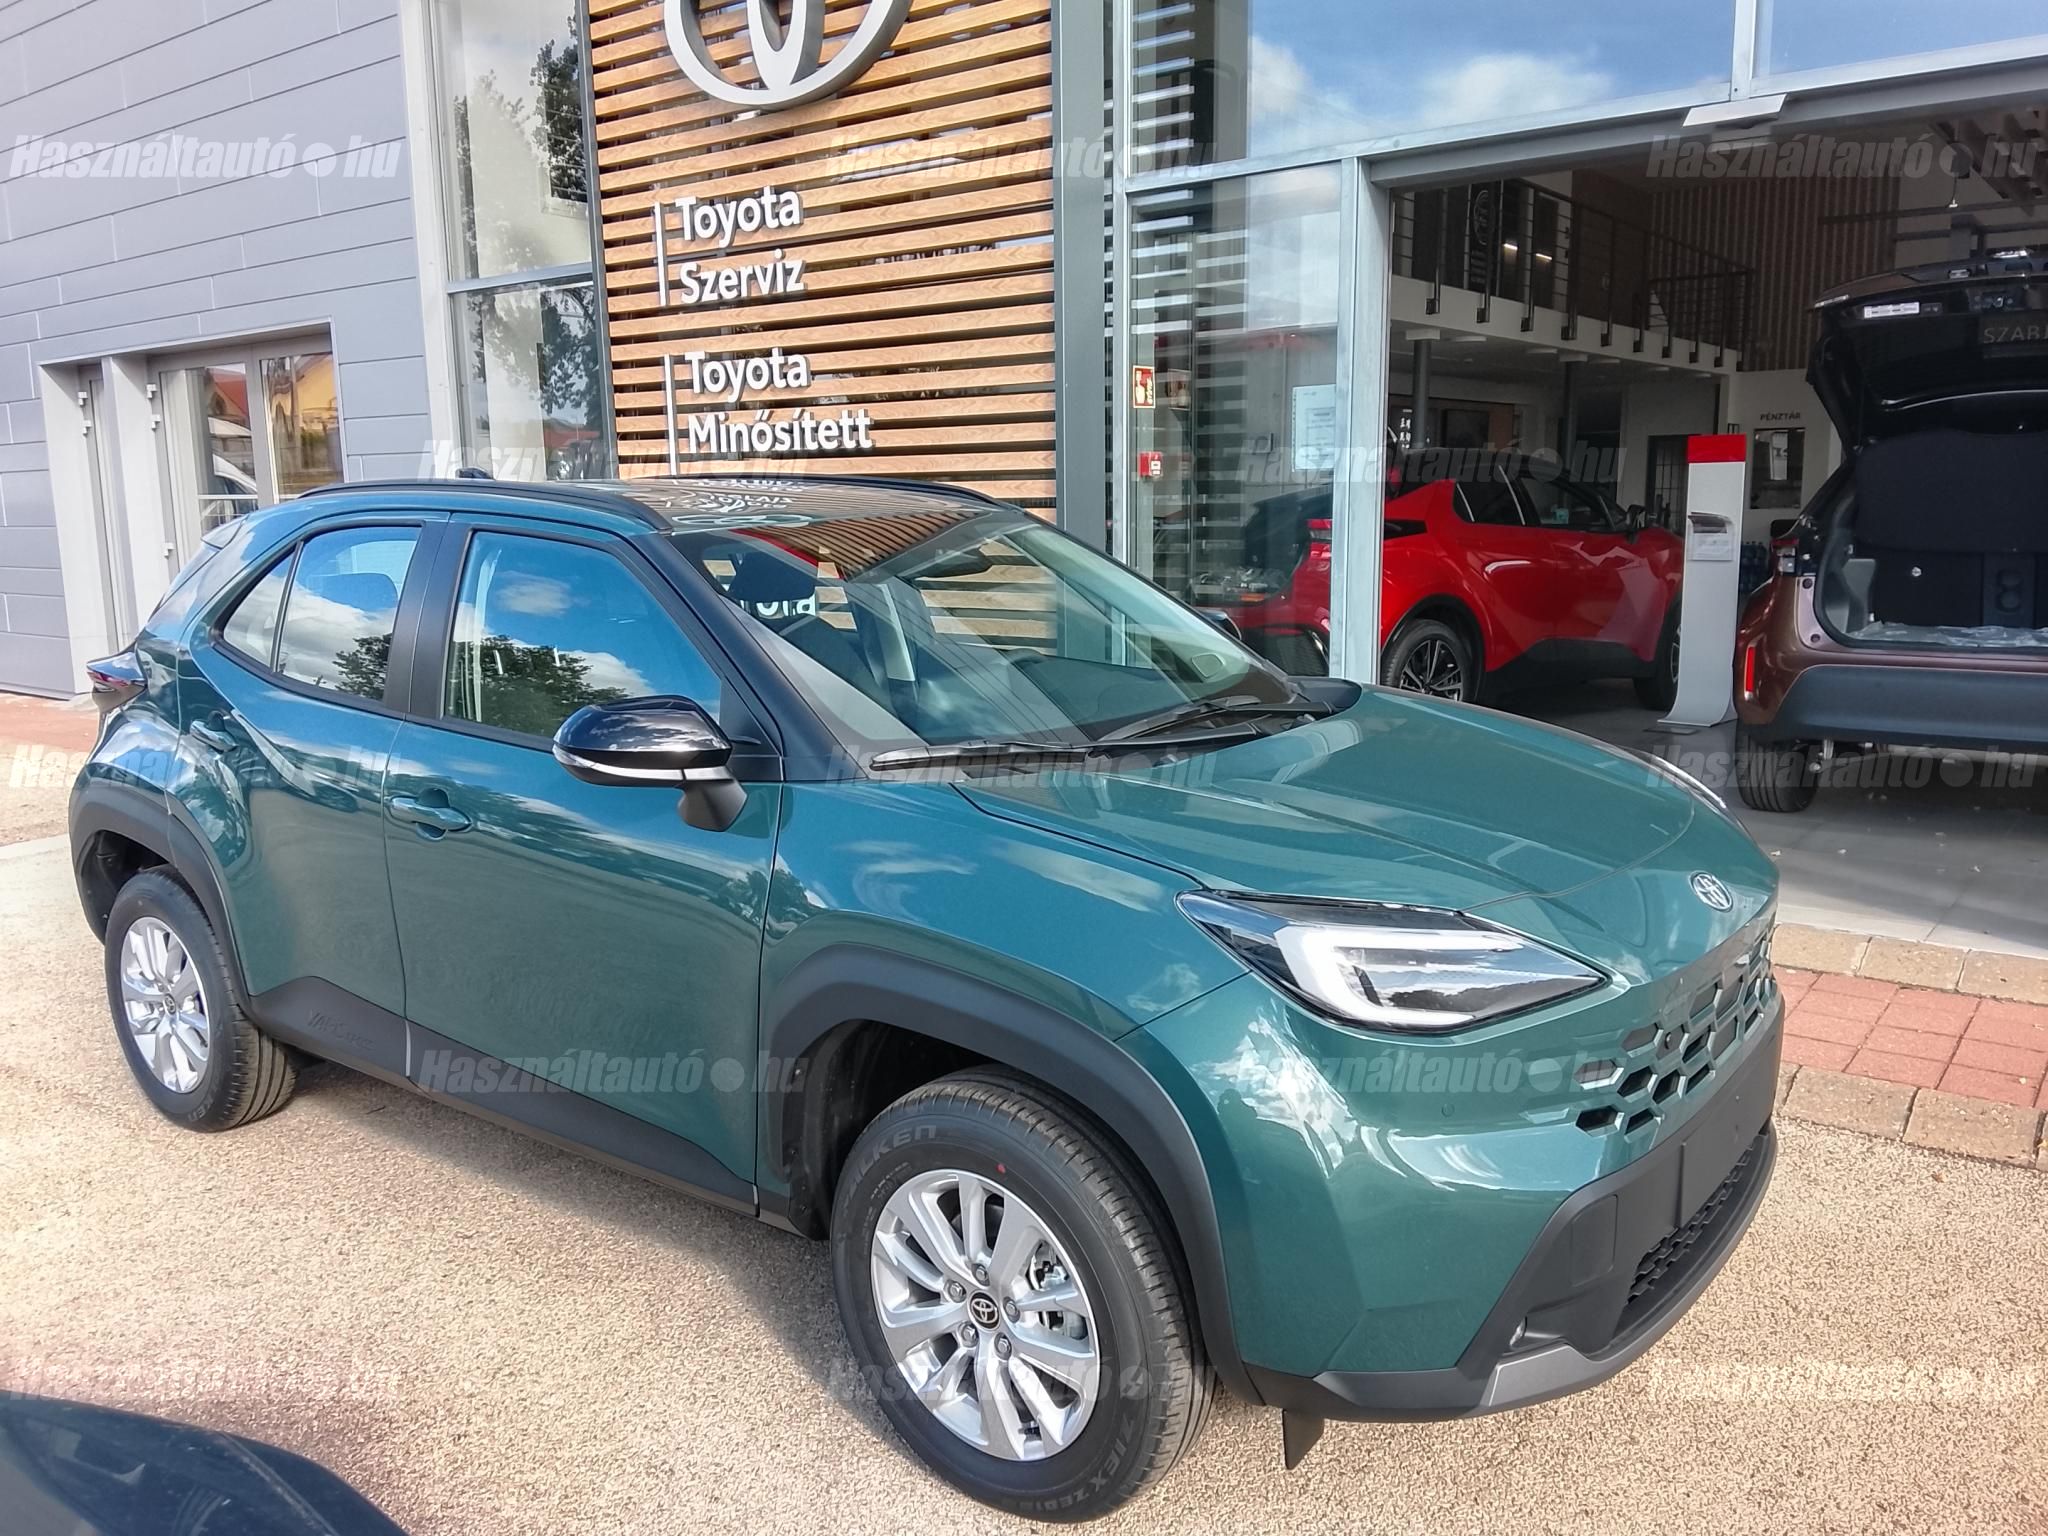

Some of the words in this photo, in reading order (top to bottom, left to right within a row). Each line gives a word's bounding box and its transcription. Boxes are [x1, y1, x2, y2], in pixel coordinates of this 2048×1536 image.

[675, 185, 803, 248] Toyota
[680, 248, 806, 304] Szerviz
[685, 347, 811, 403] Toyota
[688, 408, 874, 454] Minősített
